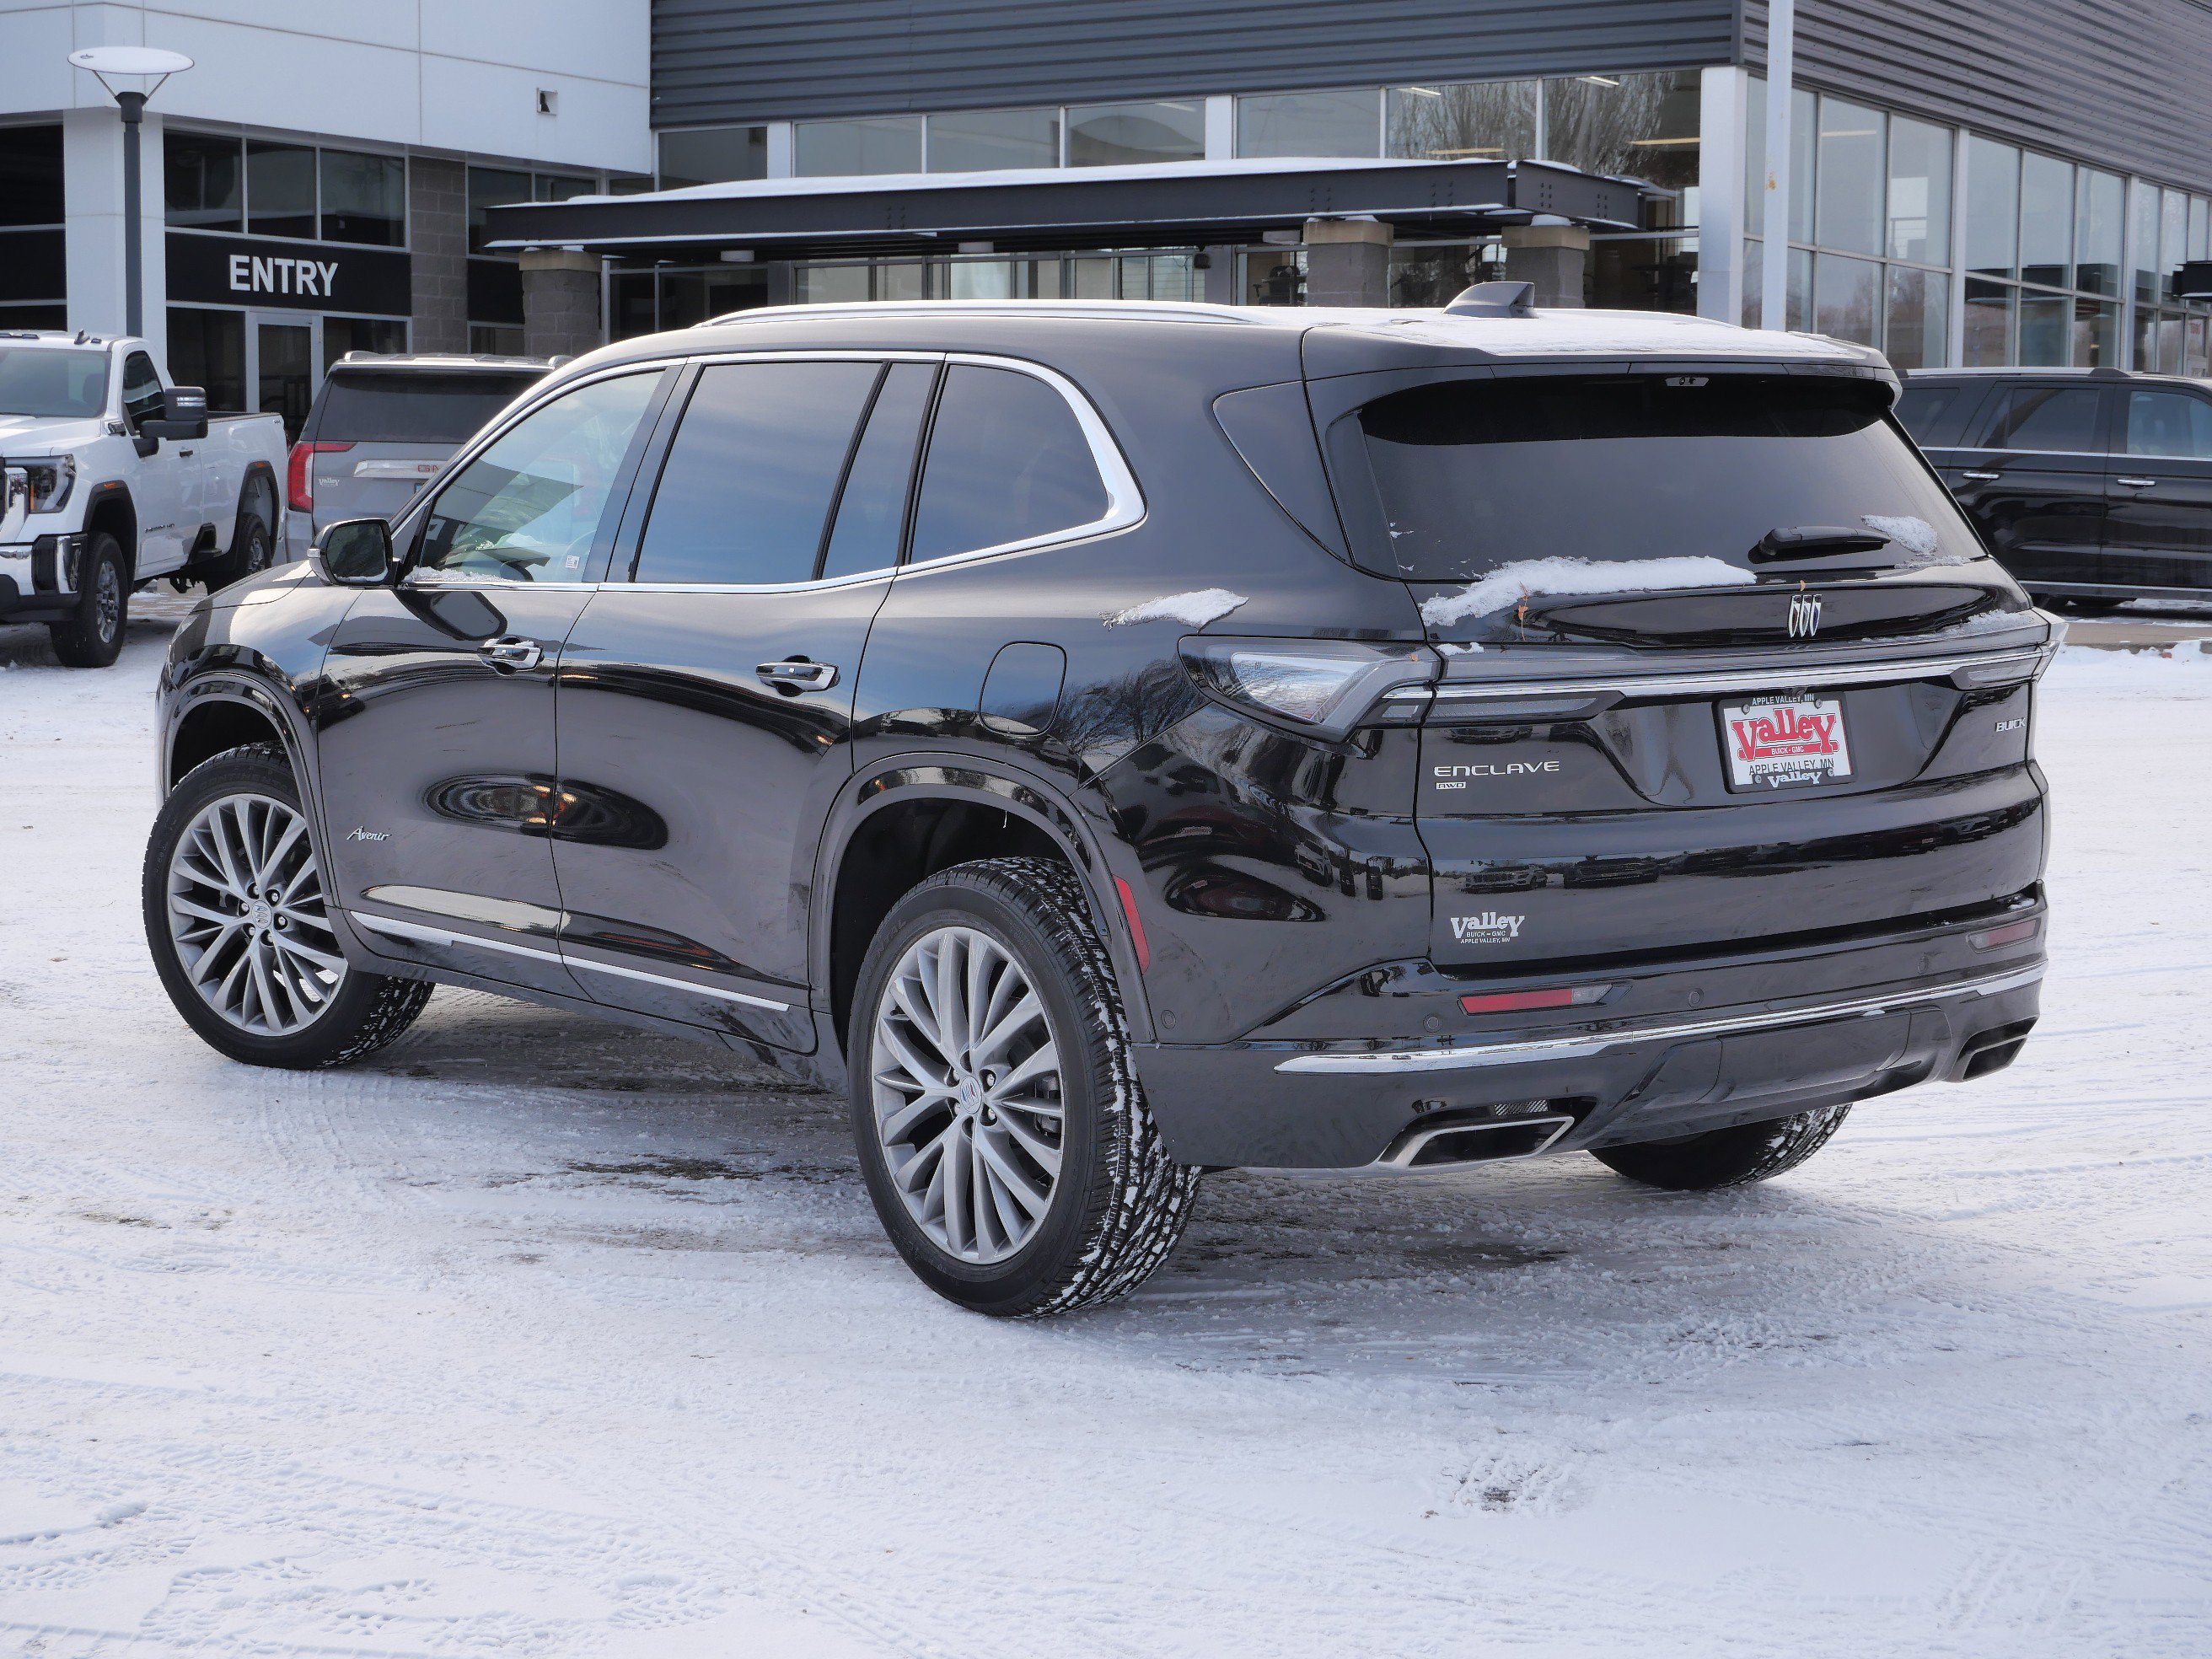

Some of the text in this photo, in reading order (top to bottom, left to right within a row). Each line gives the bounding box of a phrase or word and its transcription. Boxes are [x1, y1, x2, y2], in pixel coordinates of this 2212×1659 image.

[229, 254, 339, 297] ENTRY
[1752, 696, 1774, 706] APPLE
[1804, 693, 1814, 702] MN
[1995, 717, 2026, 733] BUICK
[1731, 707, 1837, 761] Valley
[1771, 747, 1789, 755] BUICK
[1434, 760, 1560, 777] ENCLAVE
[1749, 762, 1779, 776] APPLE
[1820, 758, 1834, 769] MN
[1767, 770, 1823, 788] Valley
[346, 825, 392, 841] Avenir
[1450, 911, 1526, 939] Valley
